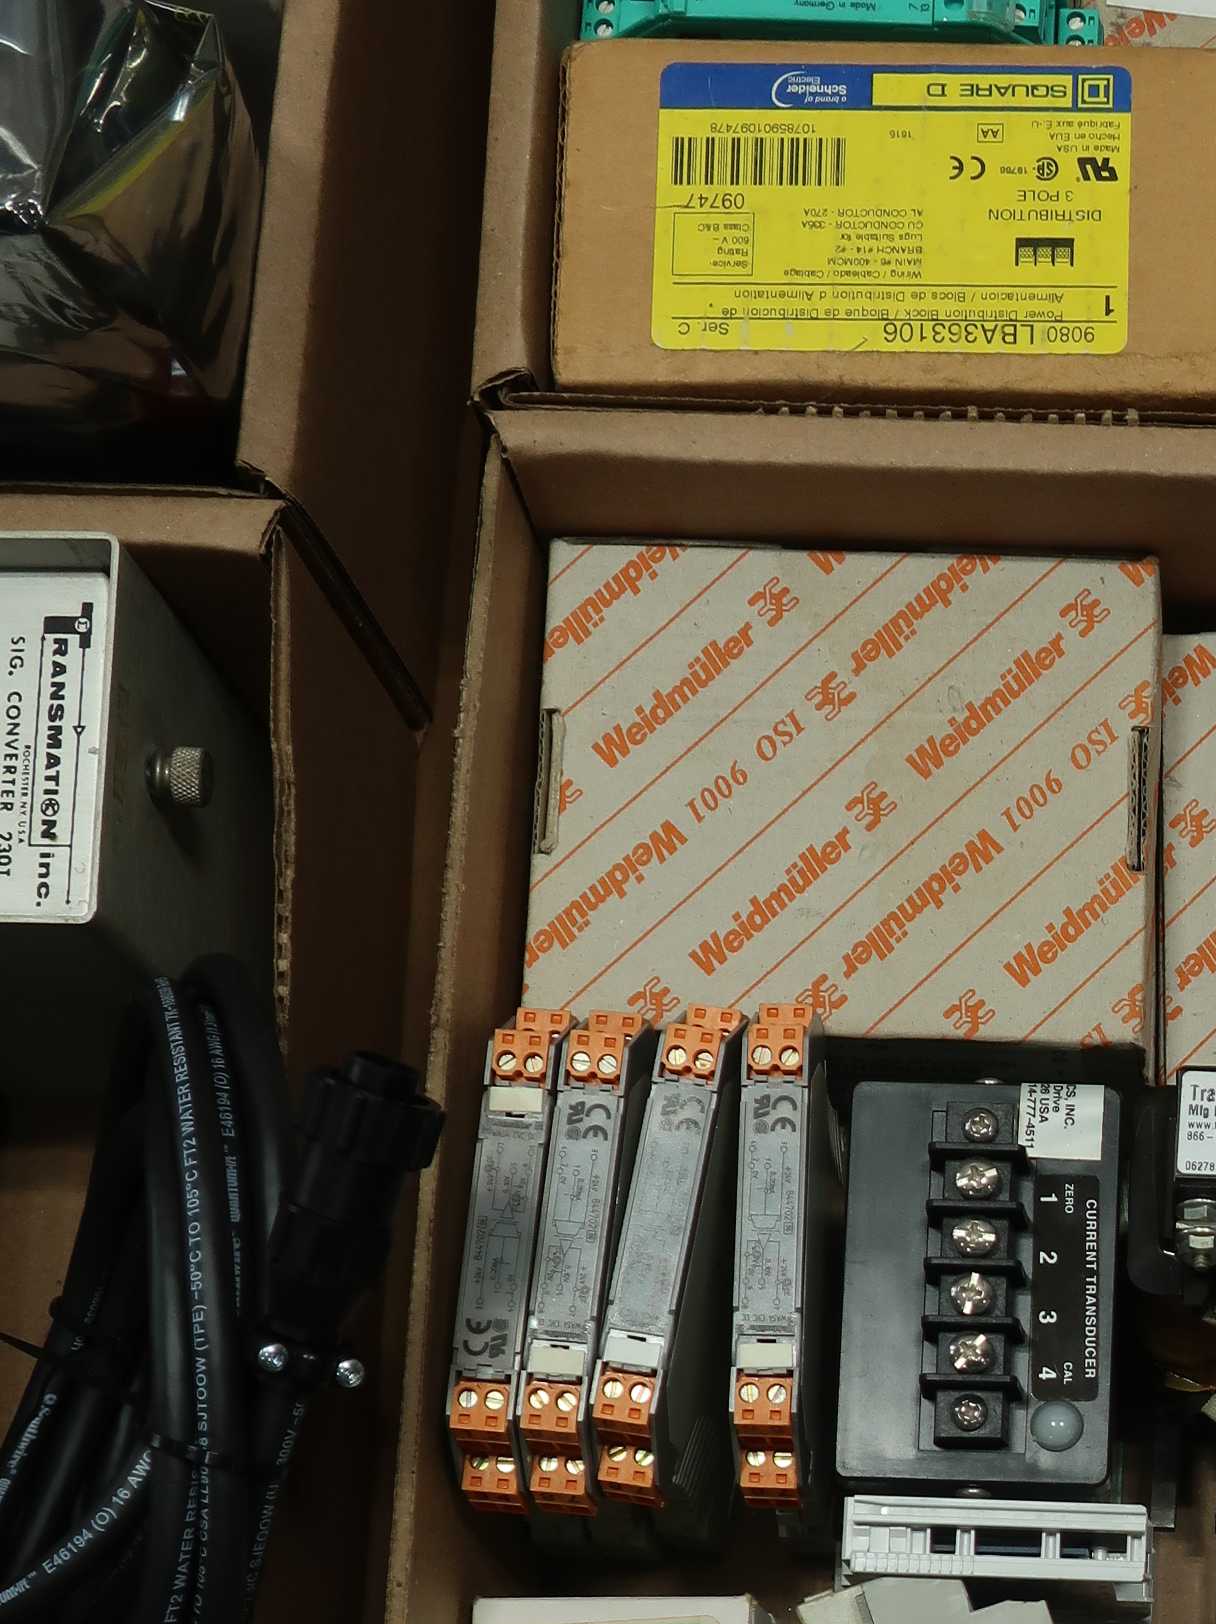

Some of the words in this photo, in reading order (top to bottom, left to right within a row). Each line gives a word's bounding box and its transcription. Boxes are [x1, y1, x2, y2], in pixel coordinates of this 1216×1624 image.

[788, 75, 820, 83] Electric
[786, 84, 847, 94] Schneider
[927, 83, 947, 97] D
[959, 83, 1067, 97] SQUARE
[710, 122, 817, 134] 10785901097478
[981, 128, 1000, 138] AA
[1056, 144, 1078, 152] USA
[1080, 145, 1090, 153] in
[1093, 144, 1120, 153] Made
[685, 193, 745, 209] 09747
[1017, 190, 1060, 202] POLE
[1065, 190, 1073, 202] 3
[835, 208, 905, 217] CONDUCTOR
[988, 209, 1102, 221] DISTRIBUTION
[835, 220, 903, 229] CONDUCTOR
[717, 247, 749, 256] Rating
[734, 289, 814, 301] Alimentation
[832, 289, 906, 302] Distribution
[910, 291, 927, 301] de
[721, 307, 737, 318] de
[844, 306, 889, 318] Bloque
[1104, 295, 1115, 316] 1
[824, 308, 840, 318] de
[904, 309, 939, 321] Block
[942, 309, 1018, 321] Distribution
[1023, 309, 1063, 321] Power
[678, 322, 690, 335] C
[697, 322, 729, 335] Ser.
[882, 322, 1035, 344] LBA363106
[1046, 326, 1095, 343] 9080
[7, 636, 26, 677] SIG.
[591, 620, 755, 769] Weidmüller
[905, 632, 1065, 782] Weidmüller
[756, 714, 806, 763] ISO
[1070, 717, 1120, 771] ISO
[0, 691, 22, 812] CONVERTER
[20, 744, 30, 798] ROCHESTER
[686, 760, 748, 825] 9001
[1002, 771, 1063, 834] 9001
[35, 851, 55, 908] inc.
[688, 825, 853, 978] Weidmüller
[842, 828, 1005, 979] Weidmüller
[167, 1022, 188, 1082] RESISTANT
[177, 1083, 195, 1136] WATER
[1039, 1098, 1050, 1123] USA
[1064, 1104, 1075, 1129] INC.
[1188, 1104, 1209, 1119] Mfg
[183, 1137, 198, 1165] FT2
[1185, 1161, 1215, 1171] 06278
[1041, 1193, 1058, 1202] 1
[1064, 1183, 1074, 1214] ZERO
[188, 1222, 201, 1246] TO
[1084, 1199, 1097, 1270] CURRENT
[1039, 1250, 1058, 1264] 2
[1039, 1310, 1057, 1324] 3
[1084, 1275, 1097, 1379] TRANSDUCER
[1038, 1366, 1057, 1380] 4
[1063, 1362, 1073, 1385] CAL
[42, 1528, 94, 1574] E46194
[91, 1507, 118, 1532] (O)
[112, 1487, 131, 1506] 16
[165, 1593, 184, 1624] FT2
